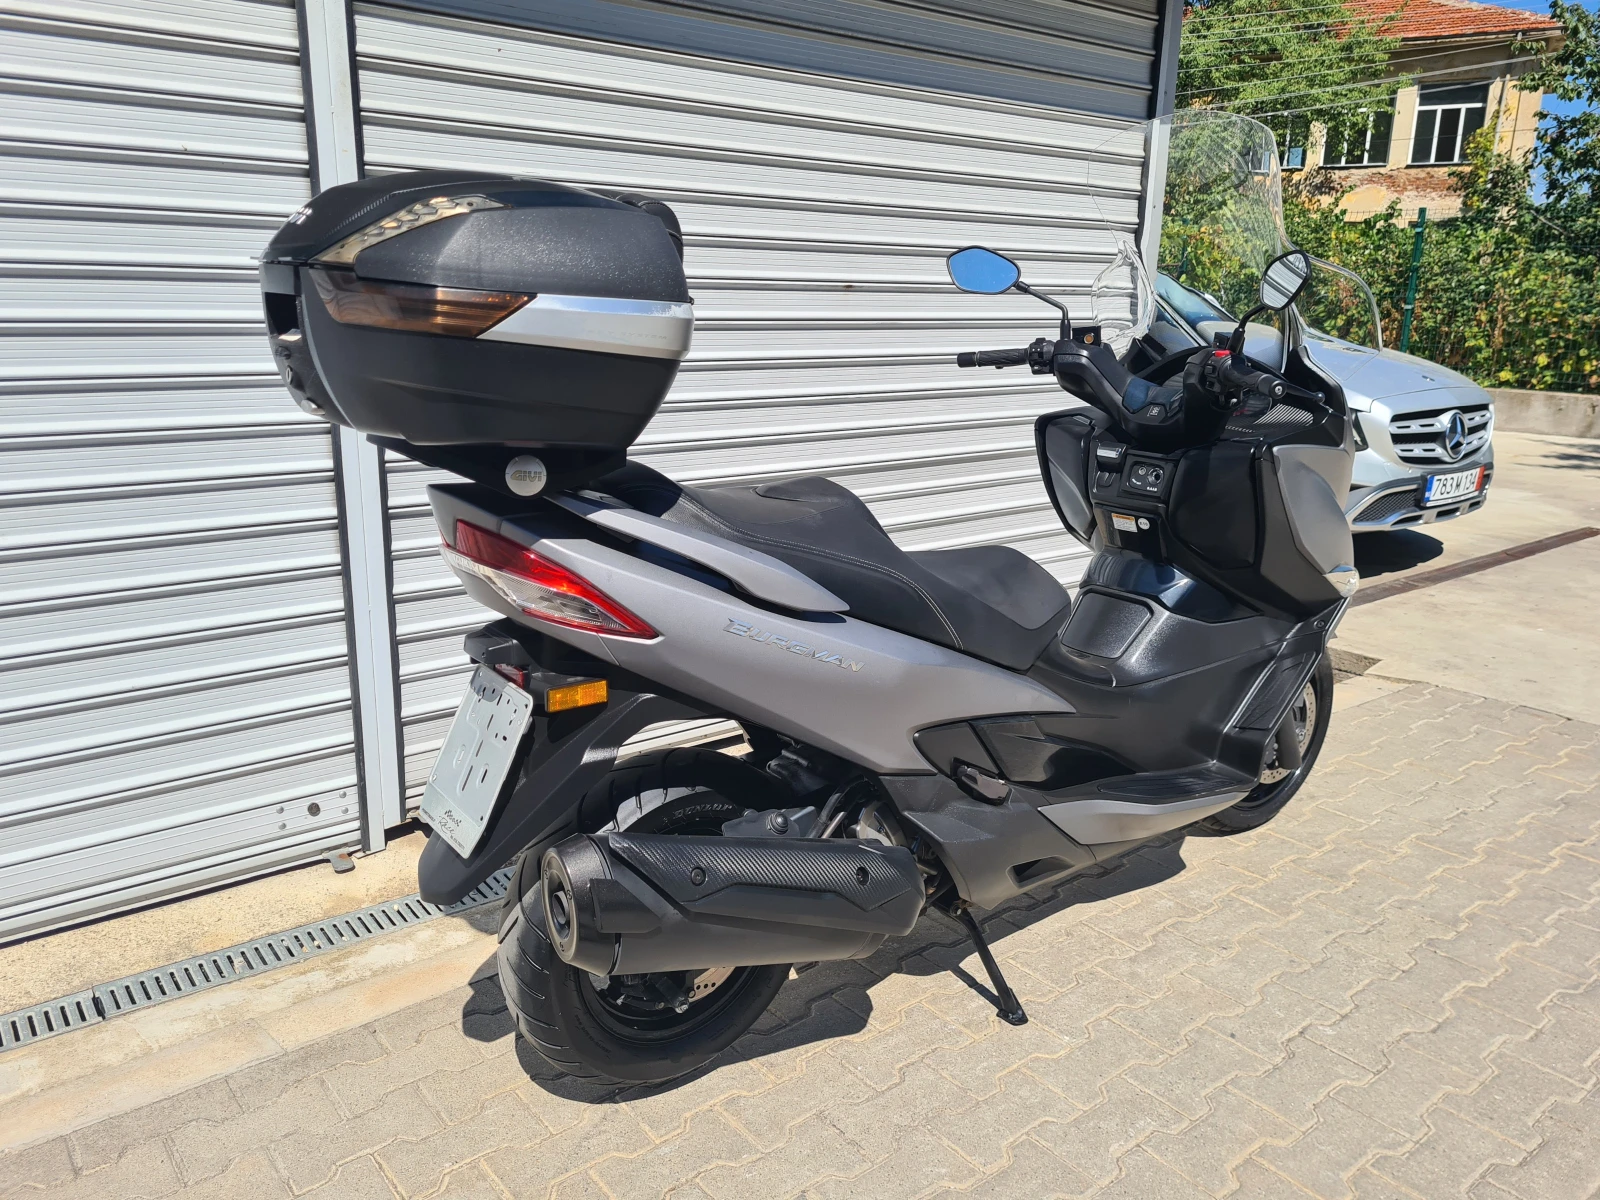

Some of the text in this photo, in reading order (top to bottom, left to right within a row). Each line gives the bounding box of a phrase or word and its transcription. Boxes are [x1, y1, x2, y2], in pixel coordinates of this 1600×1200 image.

[1432, 471, 1478, 497] 783 M 134
[722, 617, 866, 673] BURGMAN
